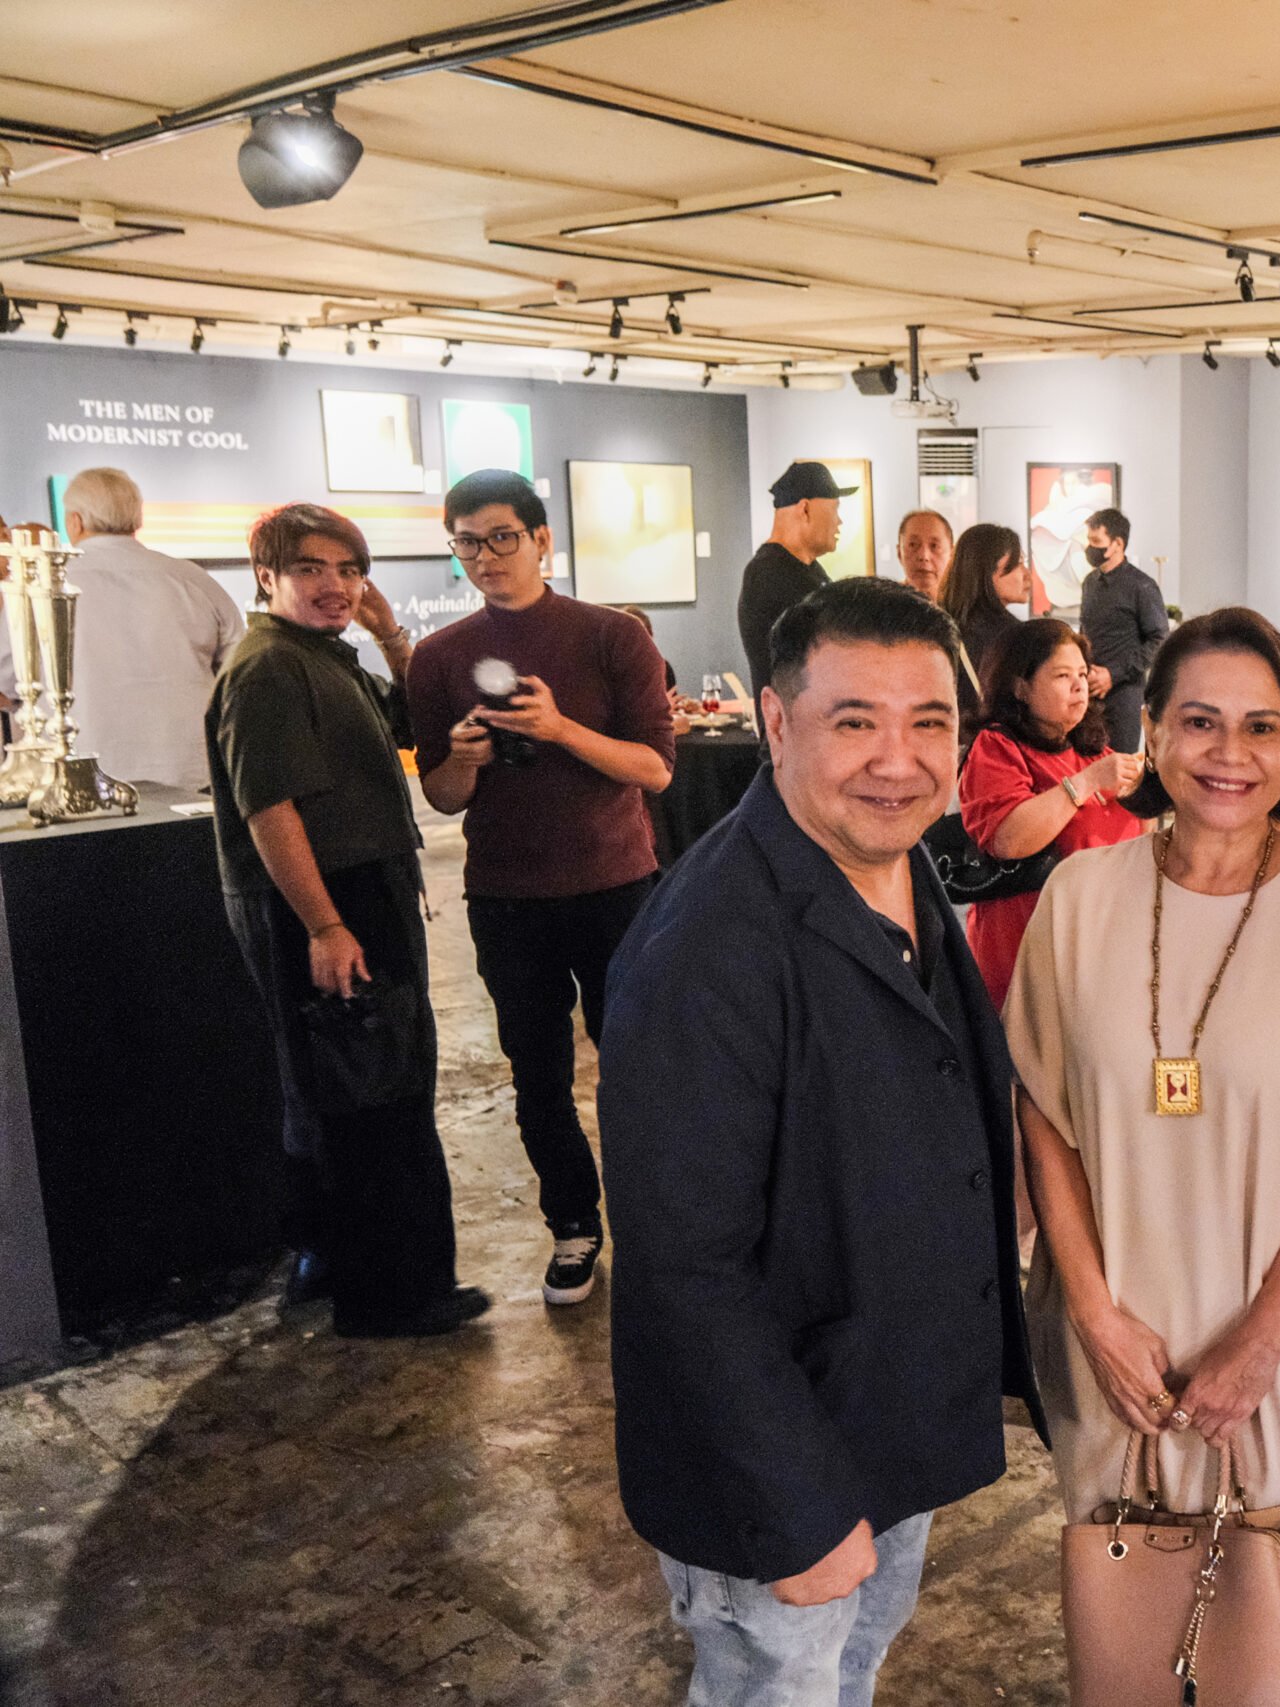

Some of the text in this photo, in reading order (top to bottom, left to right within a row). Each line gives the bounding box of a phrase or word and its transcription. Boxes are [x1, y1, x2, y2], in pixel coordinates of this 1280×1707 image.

[79, 399, 214, 425] THE MEN OF
[47, 422, 249, 450] MODERNIST COOL
